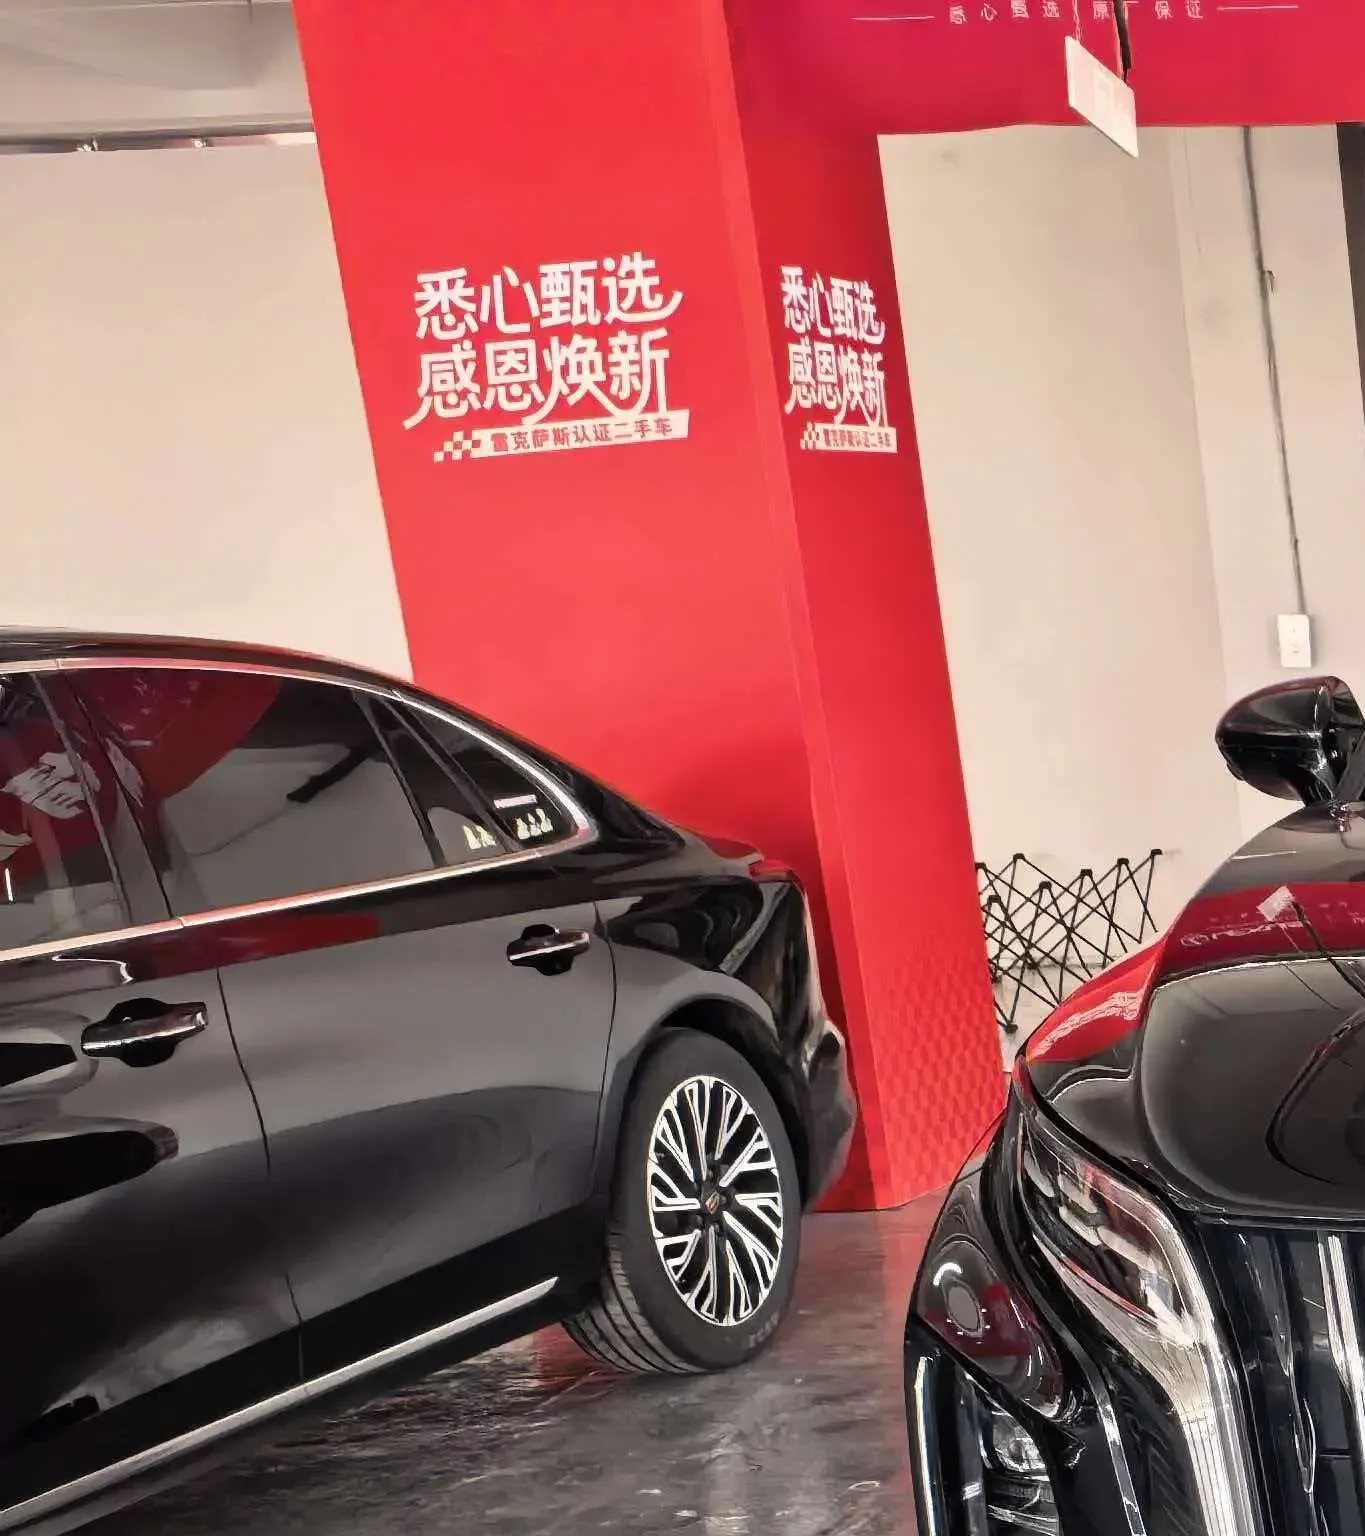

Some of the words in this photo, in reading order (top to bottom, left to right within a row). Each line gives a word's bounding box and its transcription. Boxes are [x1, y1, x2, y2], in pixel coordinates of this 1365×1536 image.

[413, 251, 684, 341] 悉心甄选
[781, 265, 885, 344] 悉心甄选
[403, 327, 670, 429] 感恩焕新
[784, 335, 888, 427] 感恩焕新
